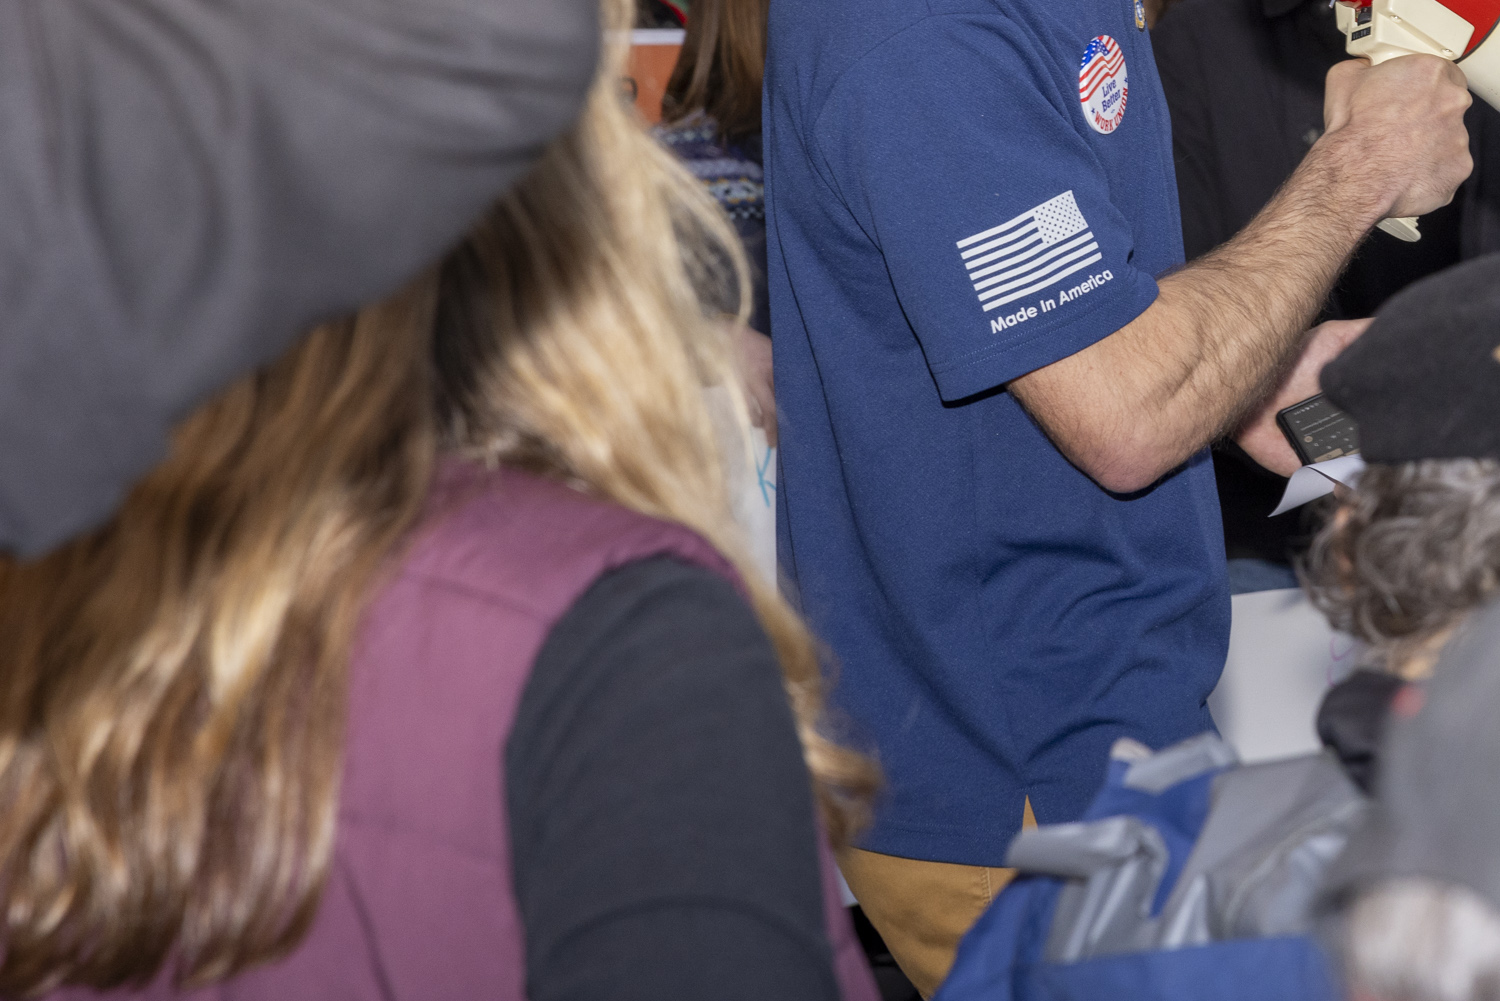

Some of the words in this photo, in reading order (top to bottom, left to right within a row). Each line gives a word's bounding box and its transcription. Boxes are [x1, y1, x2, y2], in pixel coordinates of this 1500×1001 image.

[1101, 79, 1117, 98] Live
[1101, 89, 1121, 113] Better
[1094, 110, 1114, 132] WORK
[1114, 87, 1128, 127] UNION
[990, 307, 1038, 334] Made
[1040, 299, 1057, 313] In
[1059, 269, 1114, 306] America
